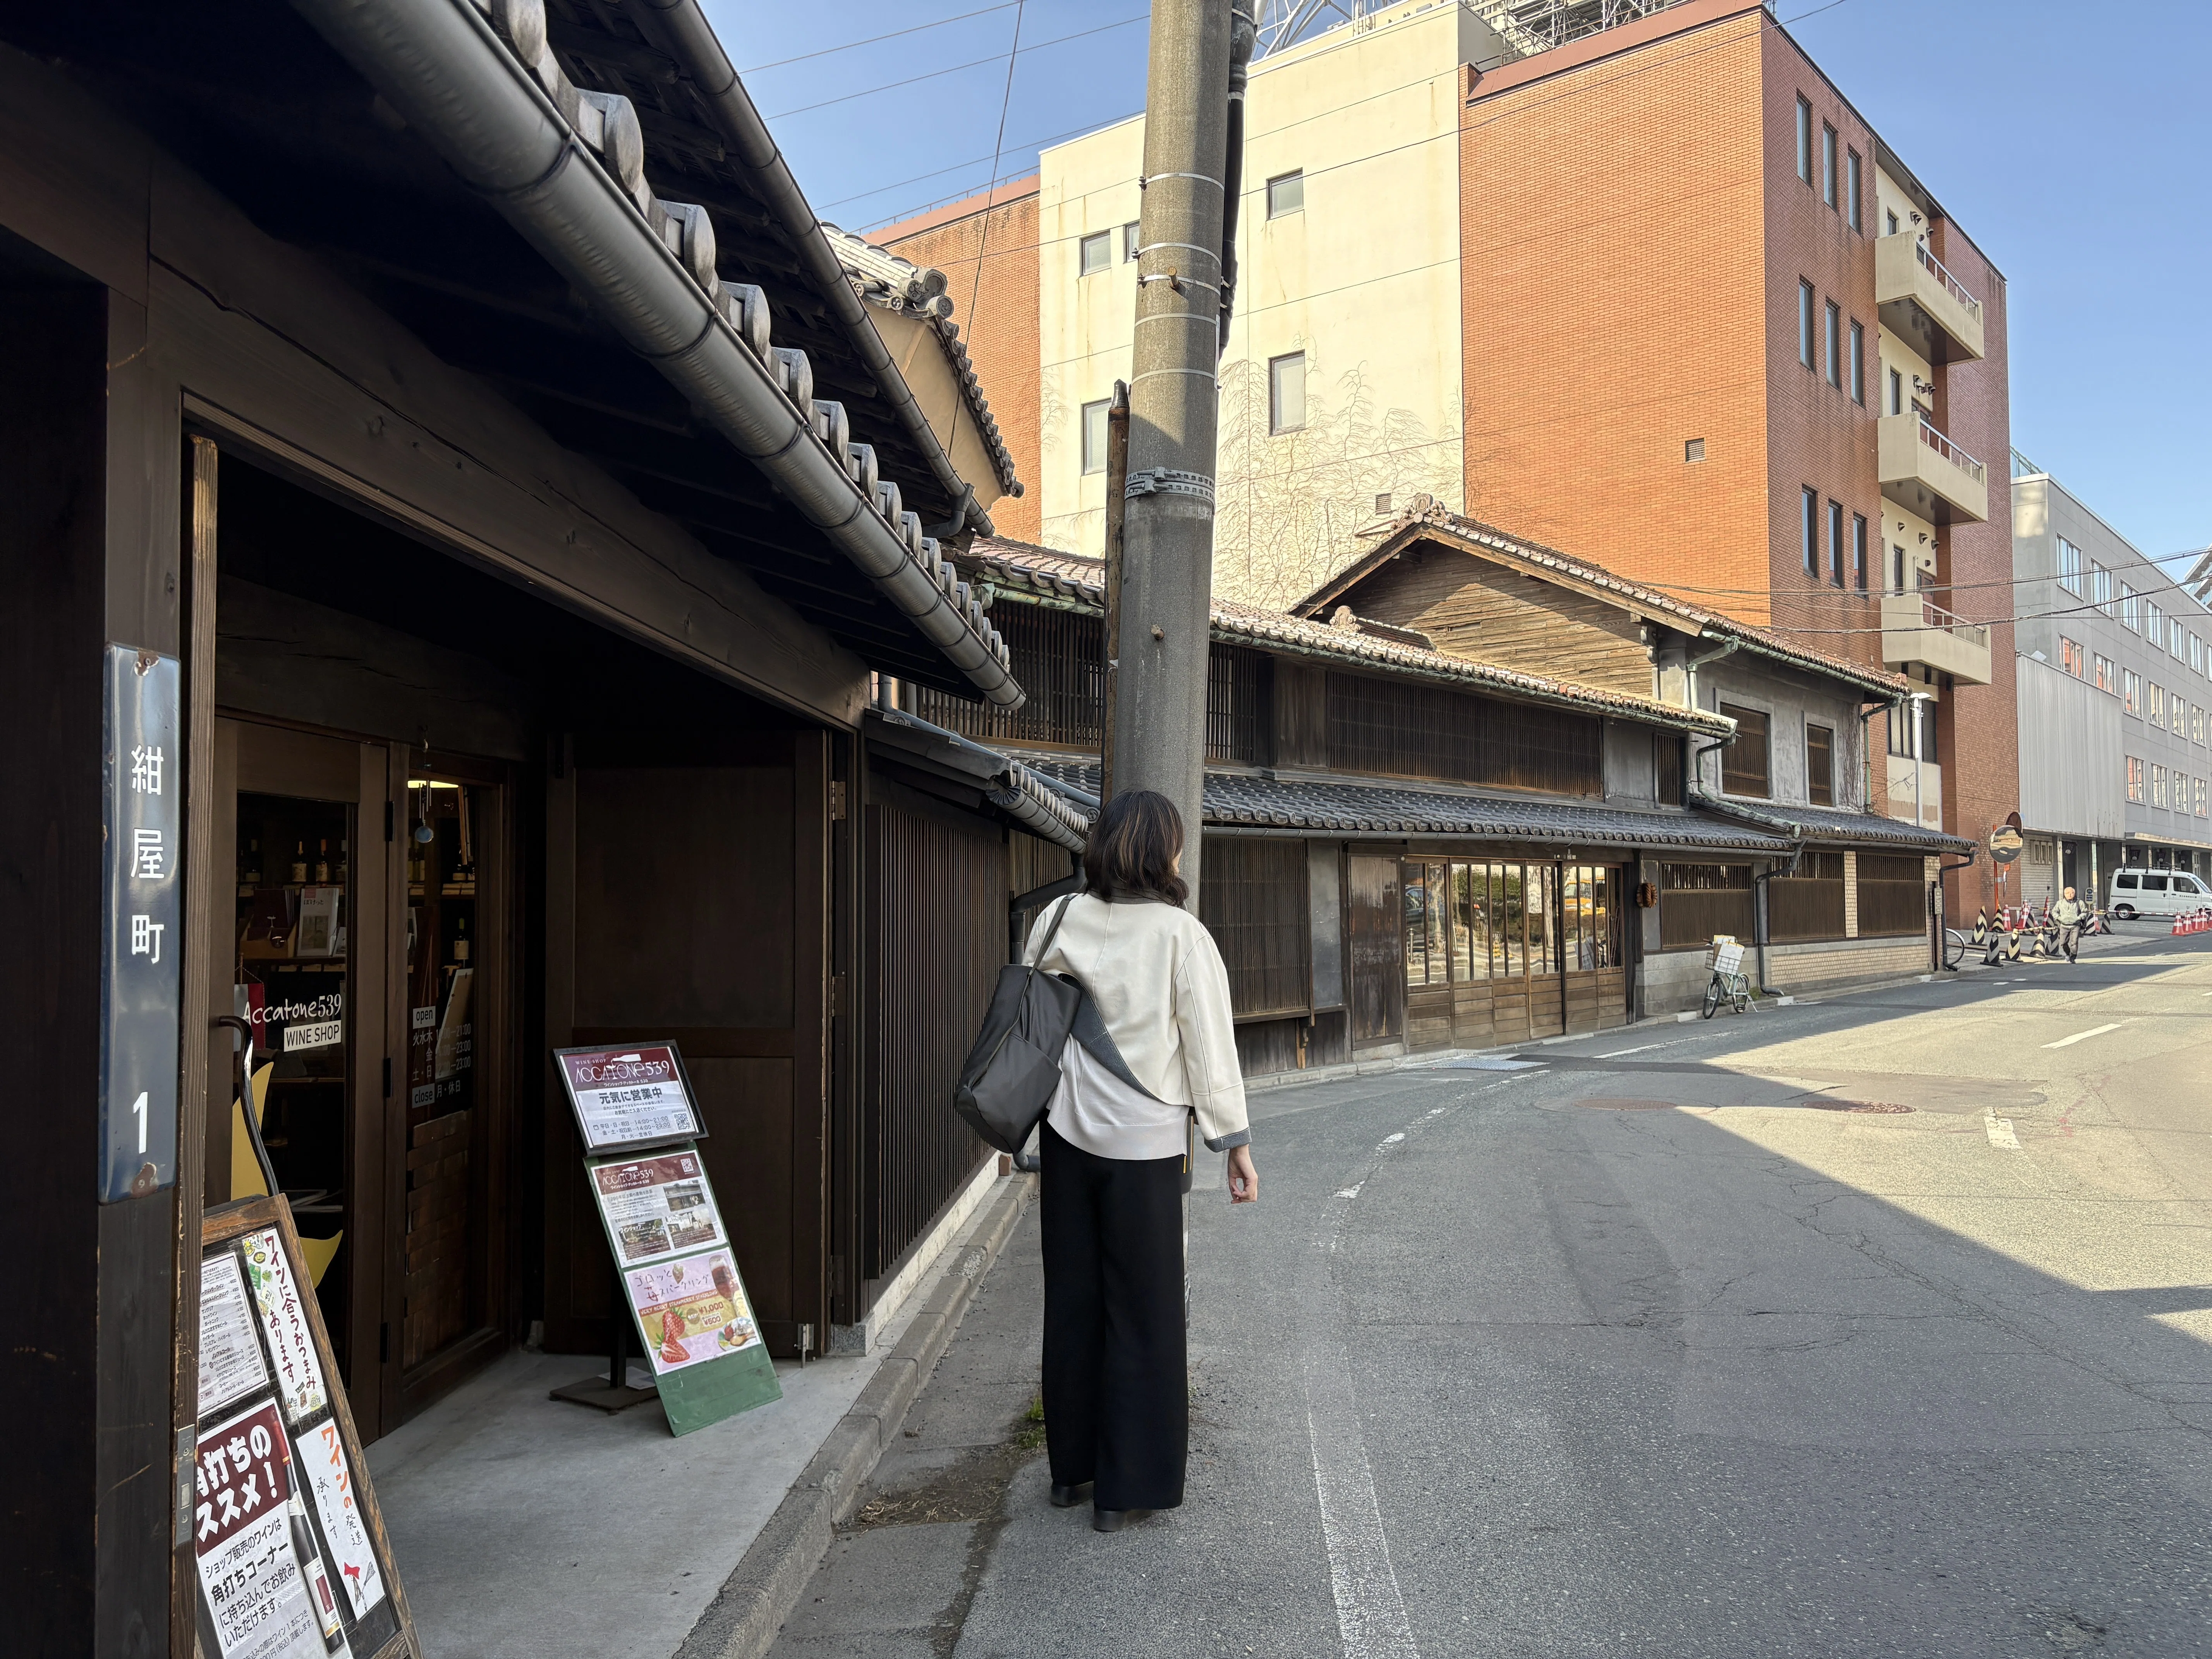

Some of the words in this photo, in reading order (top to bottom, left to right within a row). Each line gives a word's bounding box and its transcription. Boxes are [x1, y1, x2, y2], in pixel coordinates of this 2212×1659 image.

[131, 746, 164, 964] 紺屋町
[416, 1009, 433, 1024] open
[286, 1029, 312, 1047] WINE
[314, 1024, 339, 1042] SHOP
[413, 1030, 433, 1046] 火水木
[426, 1047, 433, 1061] 金
[412, 1065, 431, 1081] 土・日
[414, 1089, 433, 1104] close
[436, 1080, 460, 1098] 月・休日
[599, 1087, 662, 1104] 元気に営業中
[133, 1091, 148, 1154] 1
[635, 1269, 672, 1286] ゴロッと
[644, 1274, 709, 1302] 苺スパークリング
[265, 1235, 316, 1389] ワインに合うおつまみ
[699, 1301, 723, 1314] ¥1,000
[703, 1316, 721, 1326] ¥500
[270, 1310, 294, 1383] あります
[321, 1425, 363, 1546] ワインの発送
[317, 1477, 338, 1539] 承ります
[206, 1517, 282, 1579] ショップ販売のワインは
[211, 1543, 288, 1606] 角打ちコーナー
[219, 1563, 295, 1629] に持ち込んでお飲み
[224, 1597, 282, 1647] いただけます。
